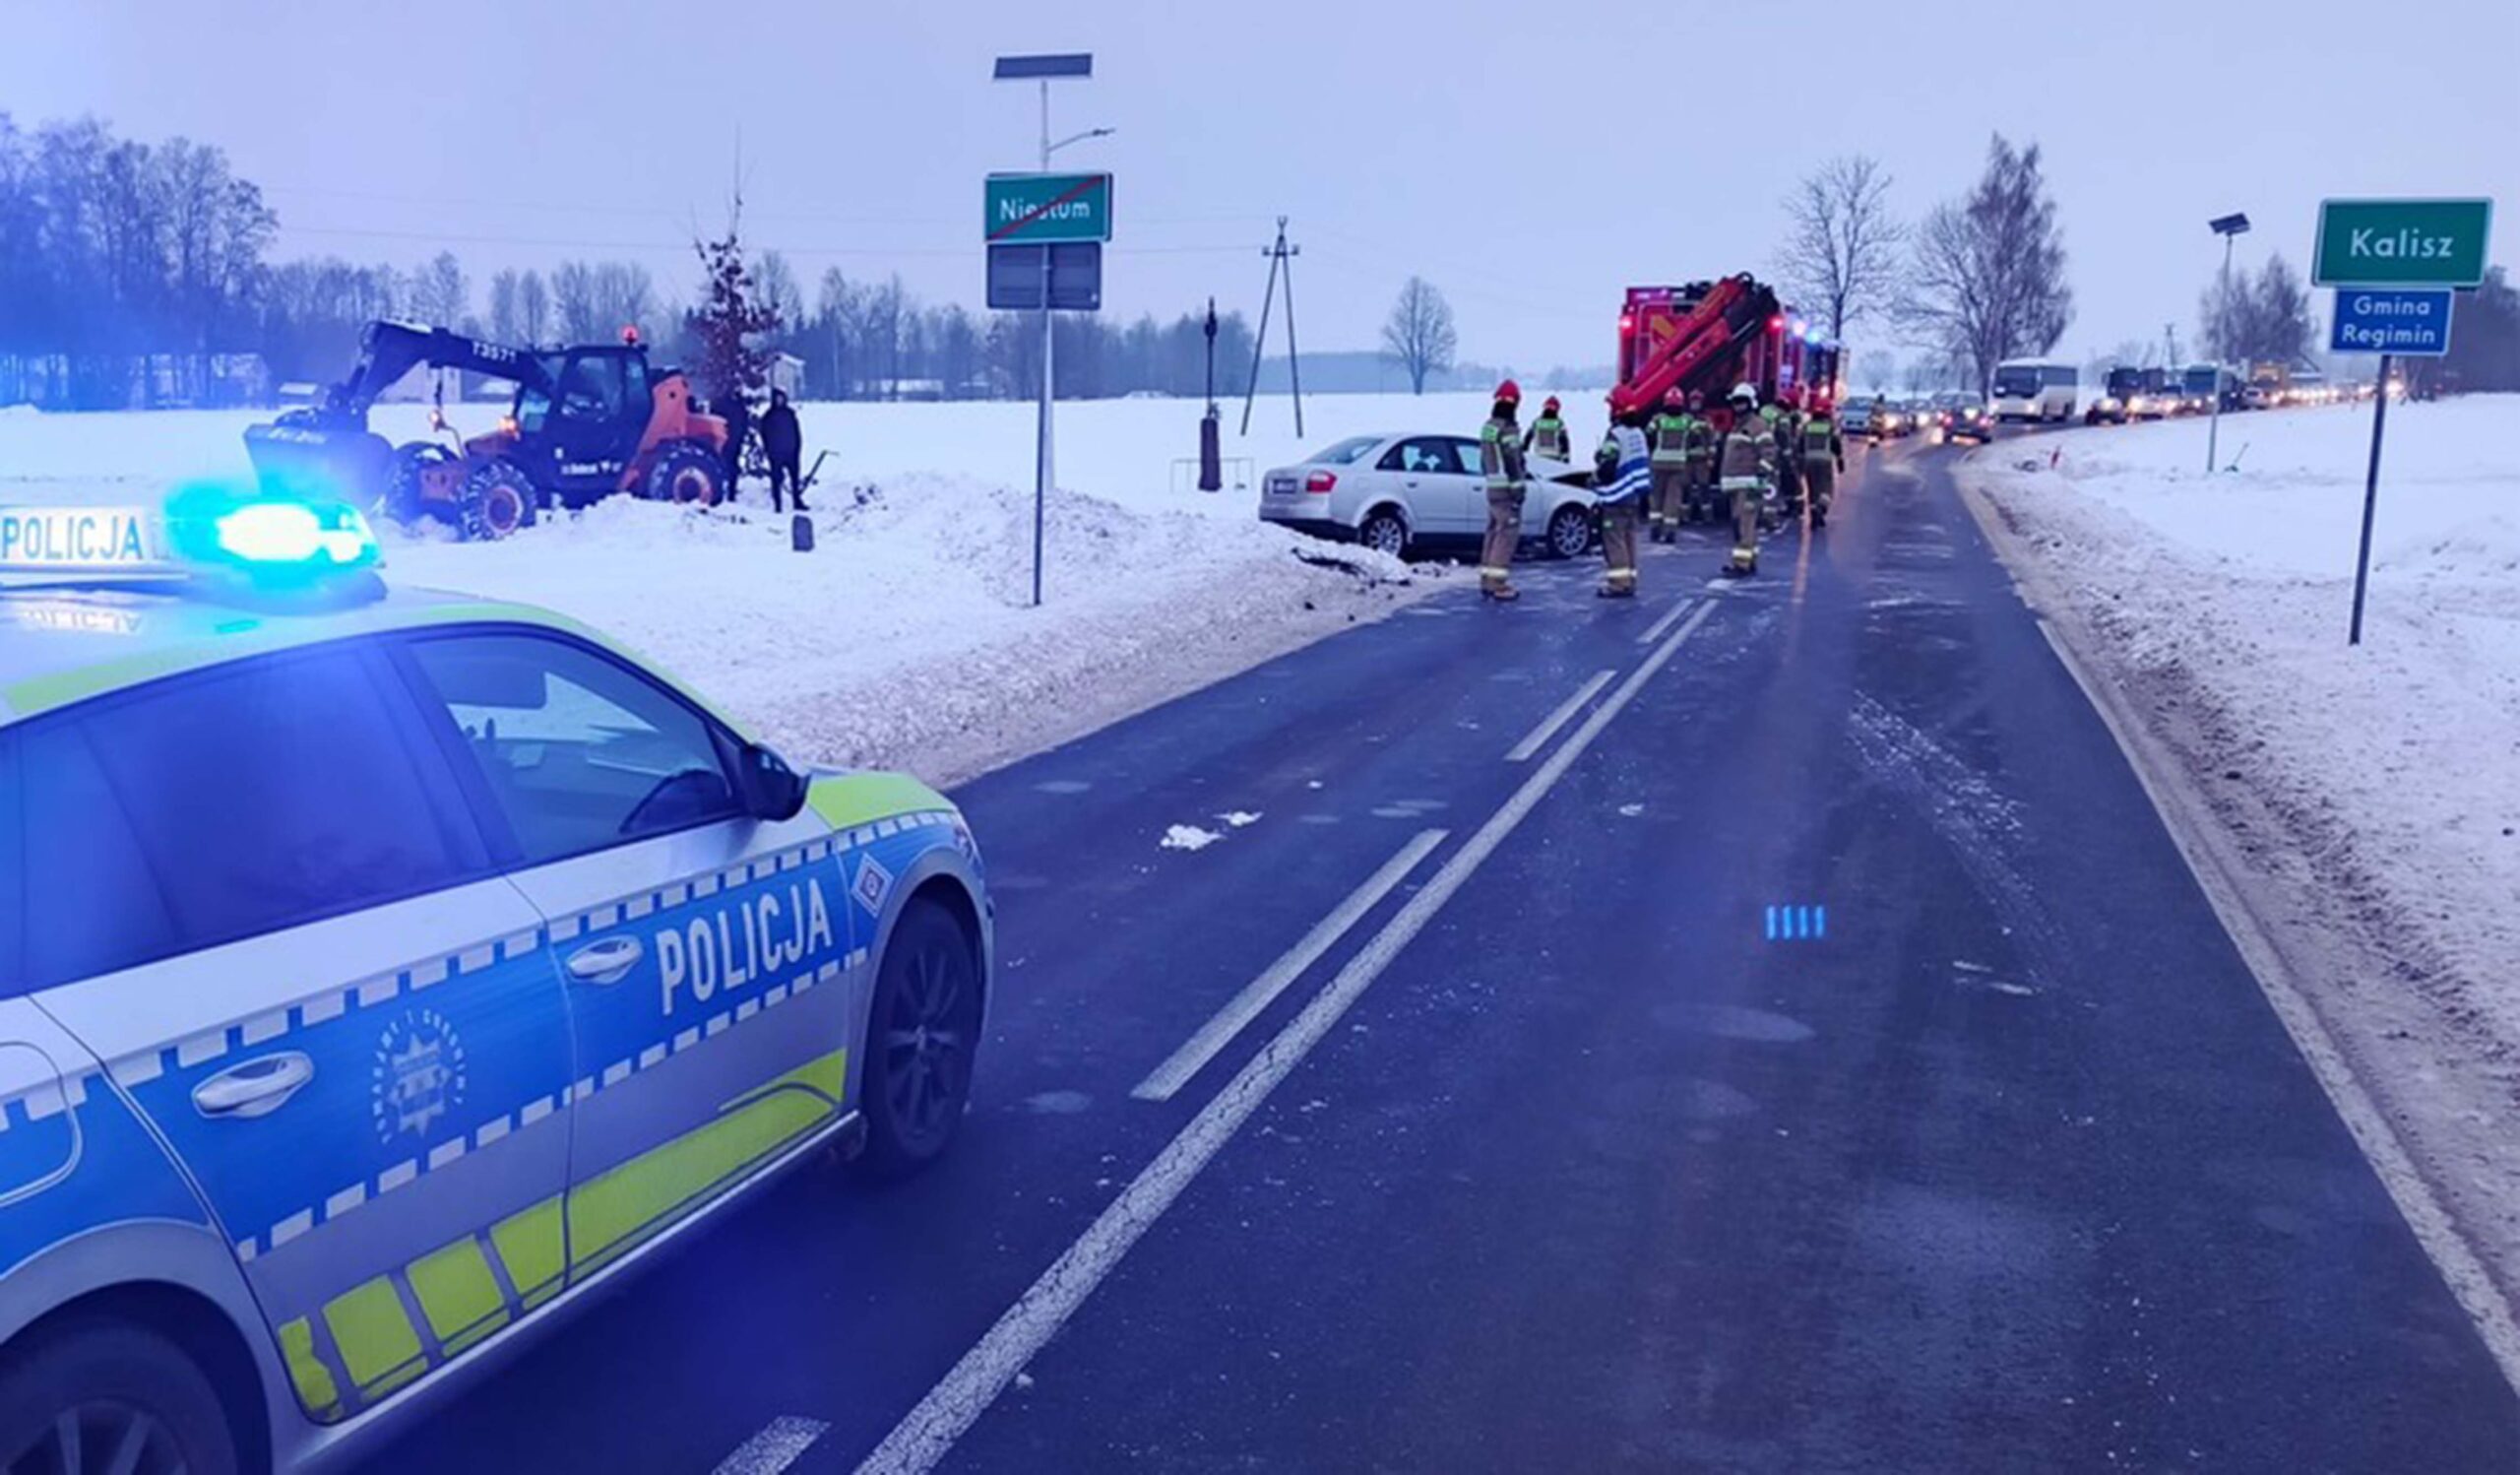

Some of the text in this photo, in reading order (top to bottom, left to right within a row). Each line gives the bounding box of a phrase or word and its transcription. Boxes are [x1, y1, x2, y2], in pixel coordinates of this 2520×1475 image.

[2350, 227, 2454, 258] Kalisz
[2354, 295, 2431, 316] Gmina
[2342, 324, 2436, 348] Regimin
[2, 515, 144, 560] POLICJA
[656, 877, 833, 1016] POLICJA
